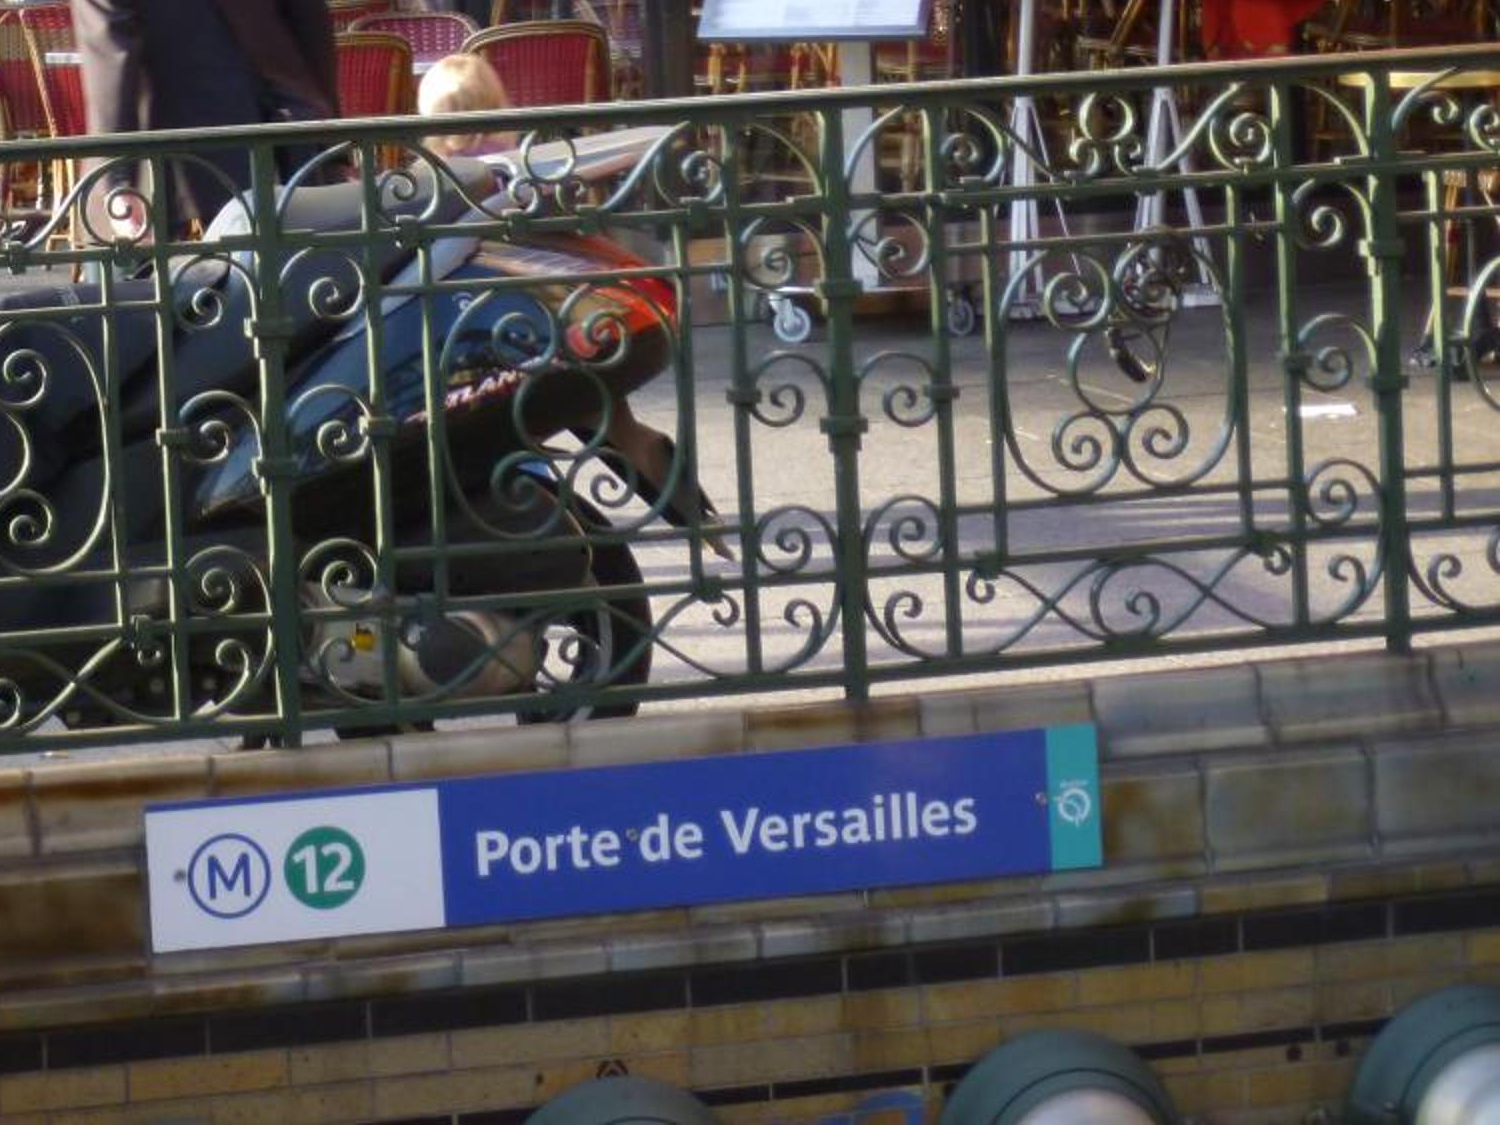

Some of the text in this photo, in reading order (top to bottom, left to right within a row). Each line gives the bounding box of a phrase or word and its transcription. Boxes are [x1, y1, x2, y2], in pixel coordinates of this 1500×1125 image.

[206, 790, 979, 900] M 12 Porte de Versailles
